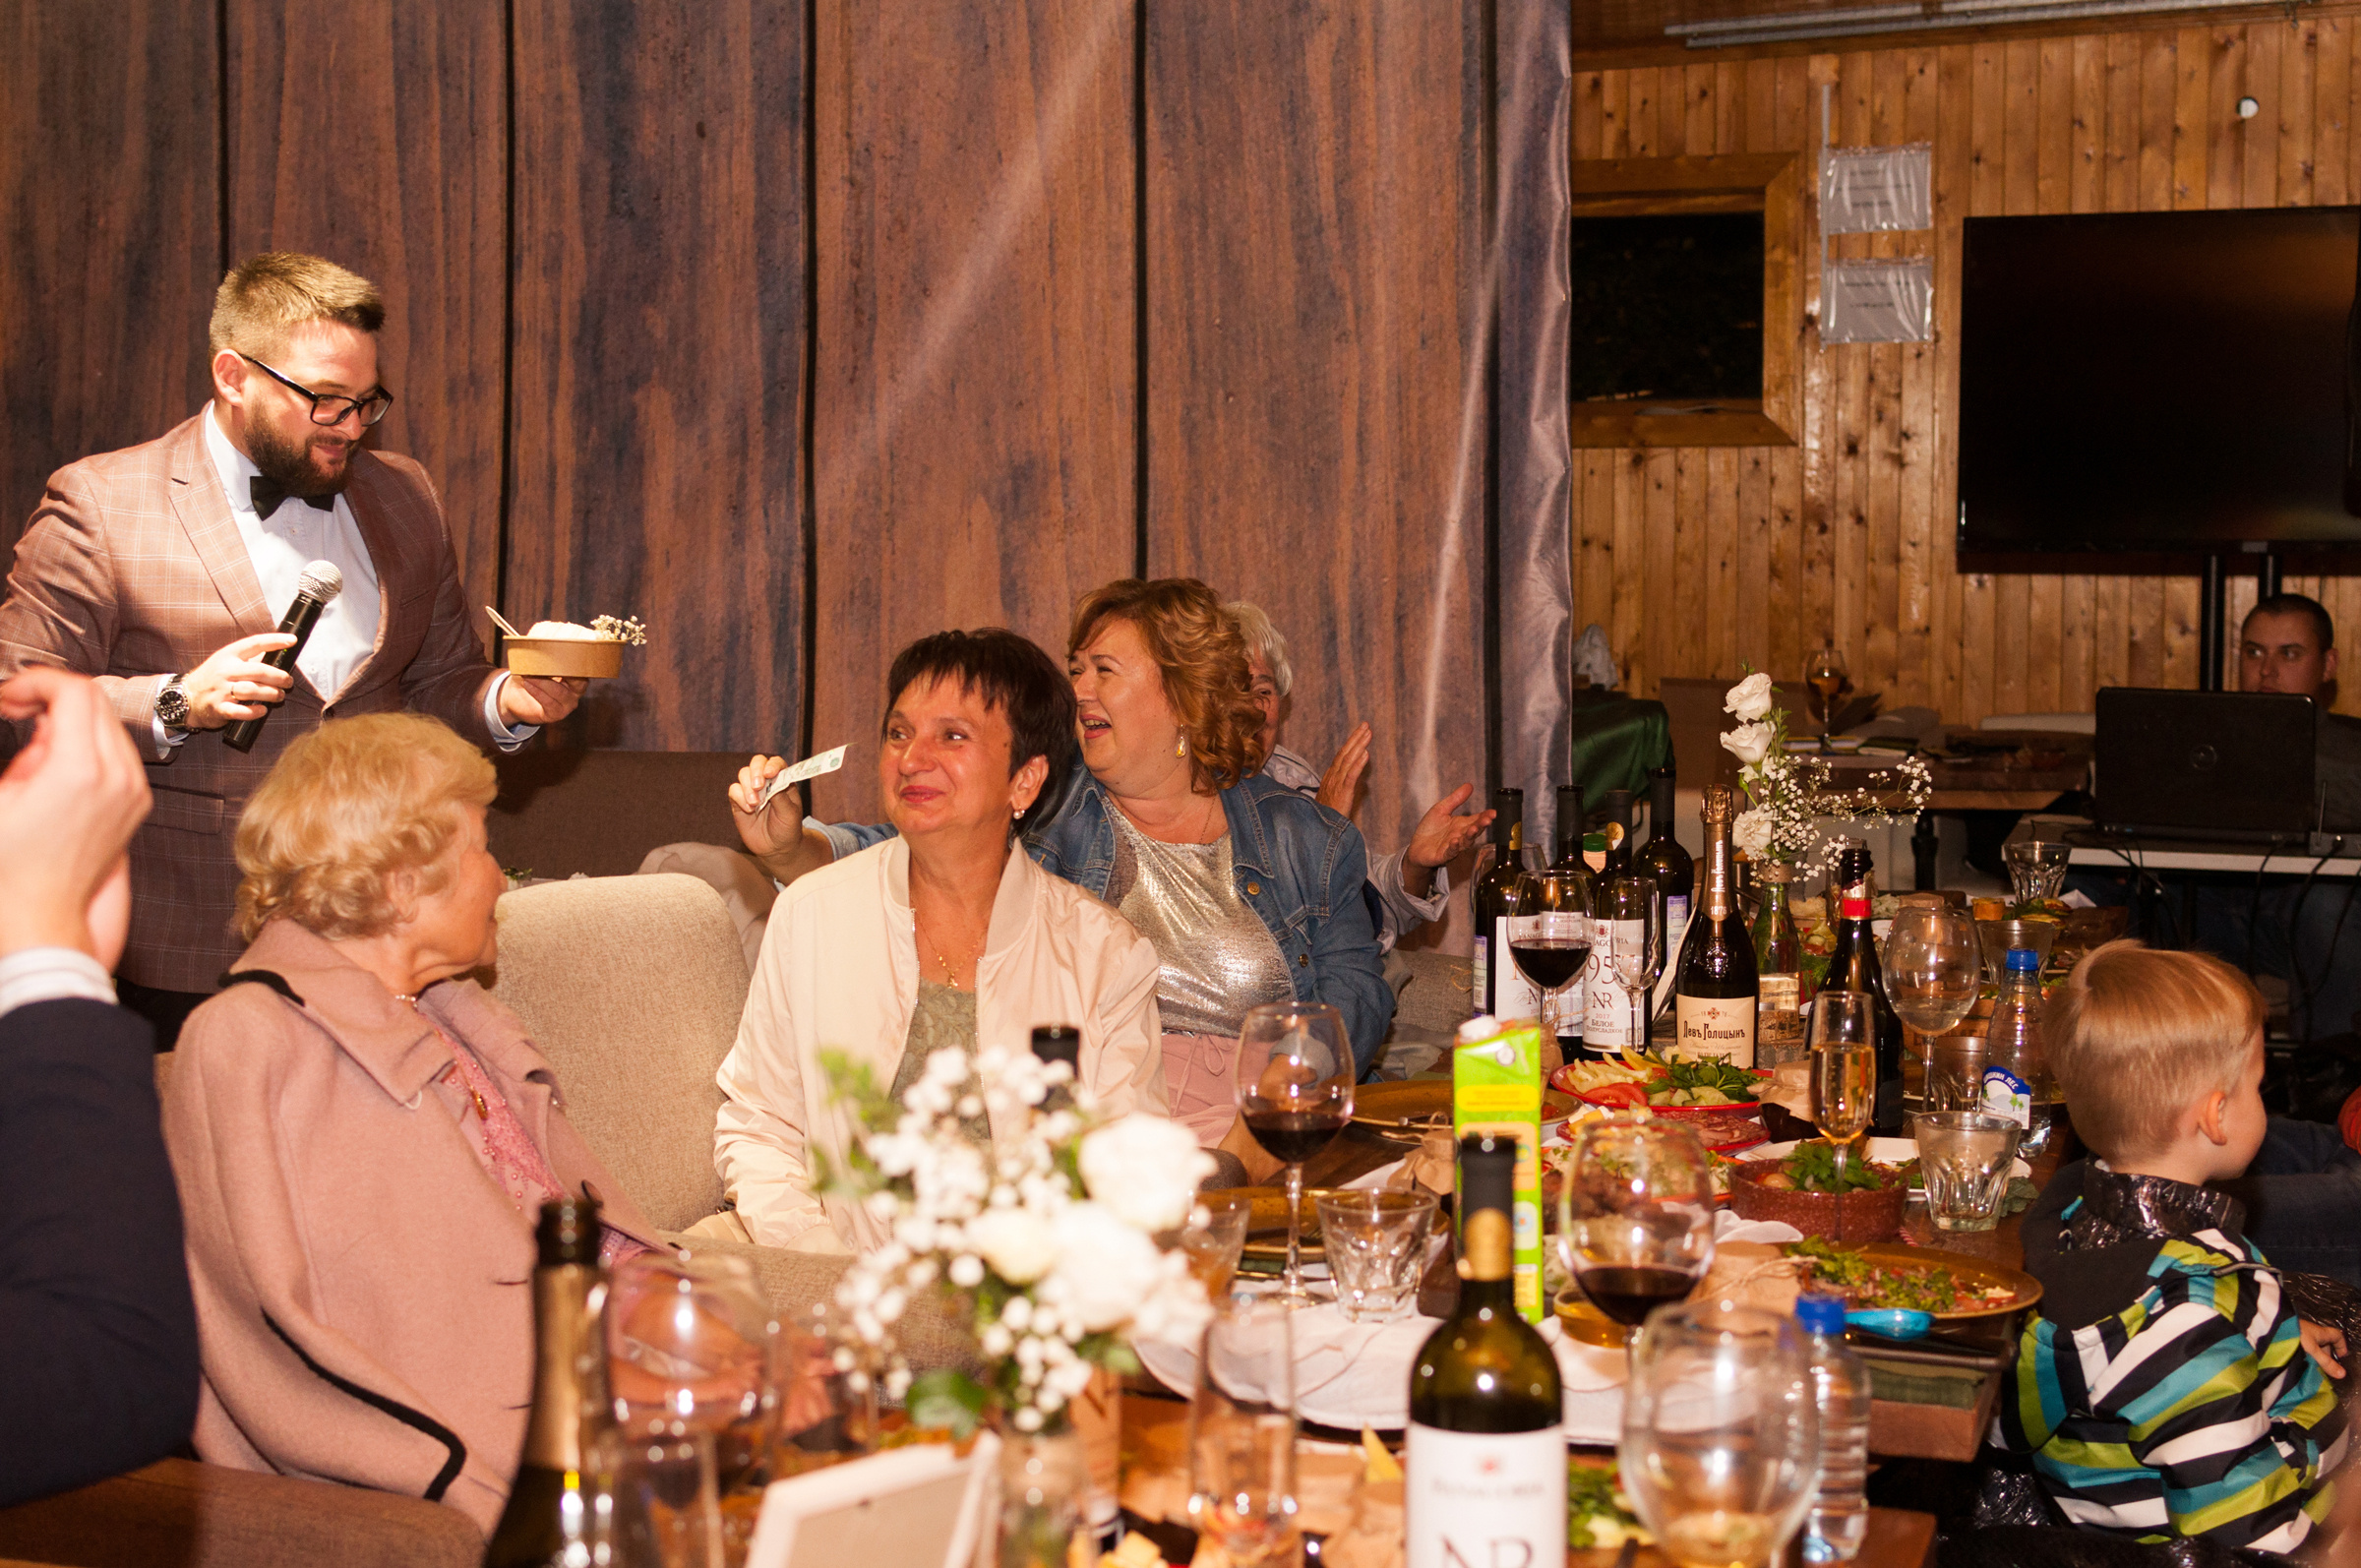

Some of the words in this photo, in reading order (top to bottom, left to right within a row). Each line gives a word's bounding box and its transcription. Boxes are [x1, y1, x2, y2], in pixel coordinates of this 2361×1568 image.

[1592, 991, 1614, 1010] NR
[1591, 1018, 1614, 1028] БЕЛОЕ
[1683, 1020, 1702, 1038] Левъ
[1703, 1023, 1745, 1041] Голицынъ
[2004, 1076, 2019, 1090] ЛЕС
